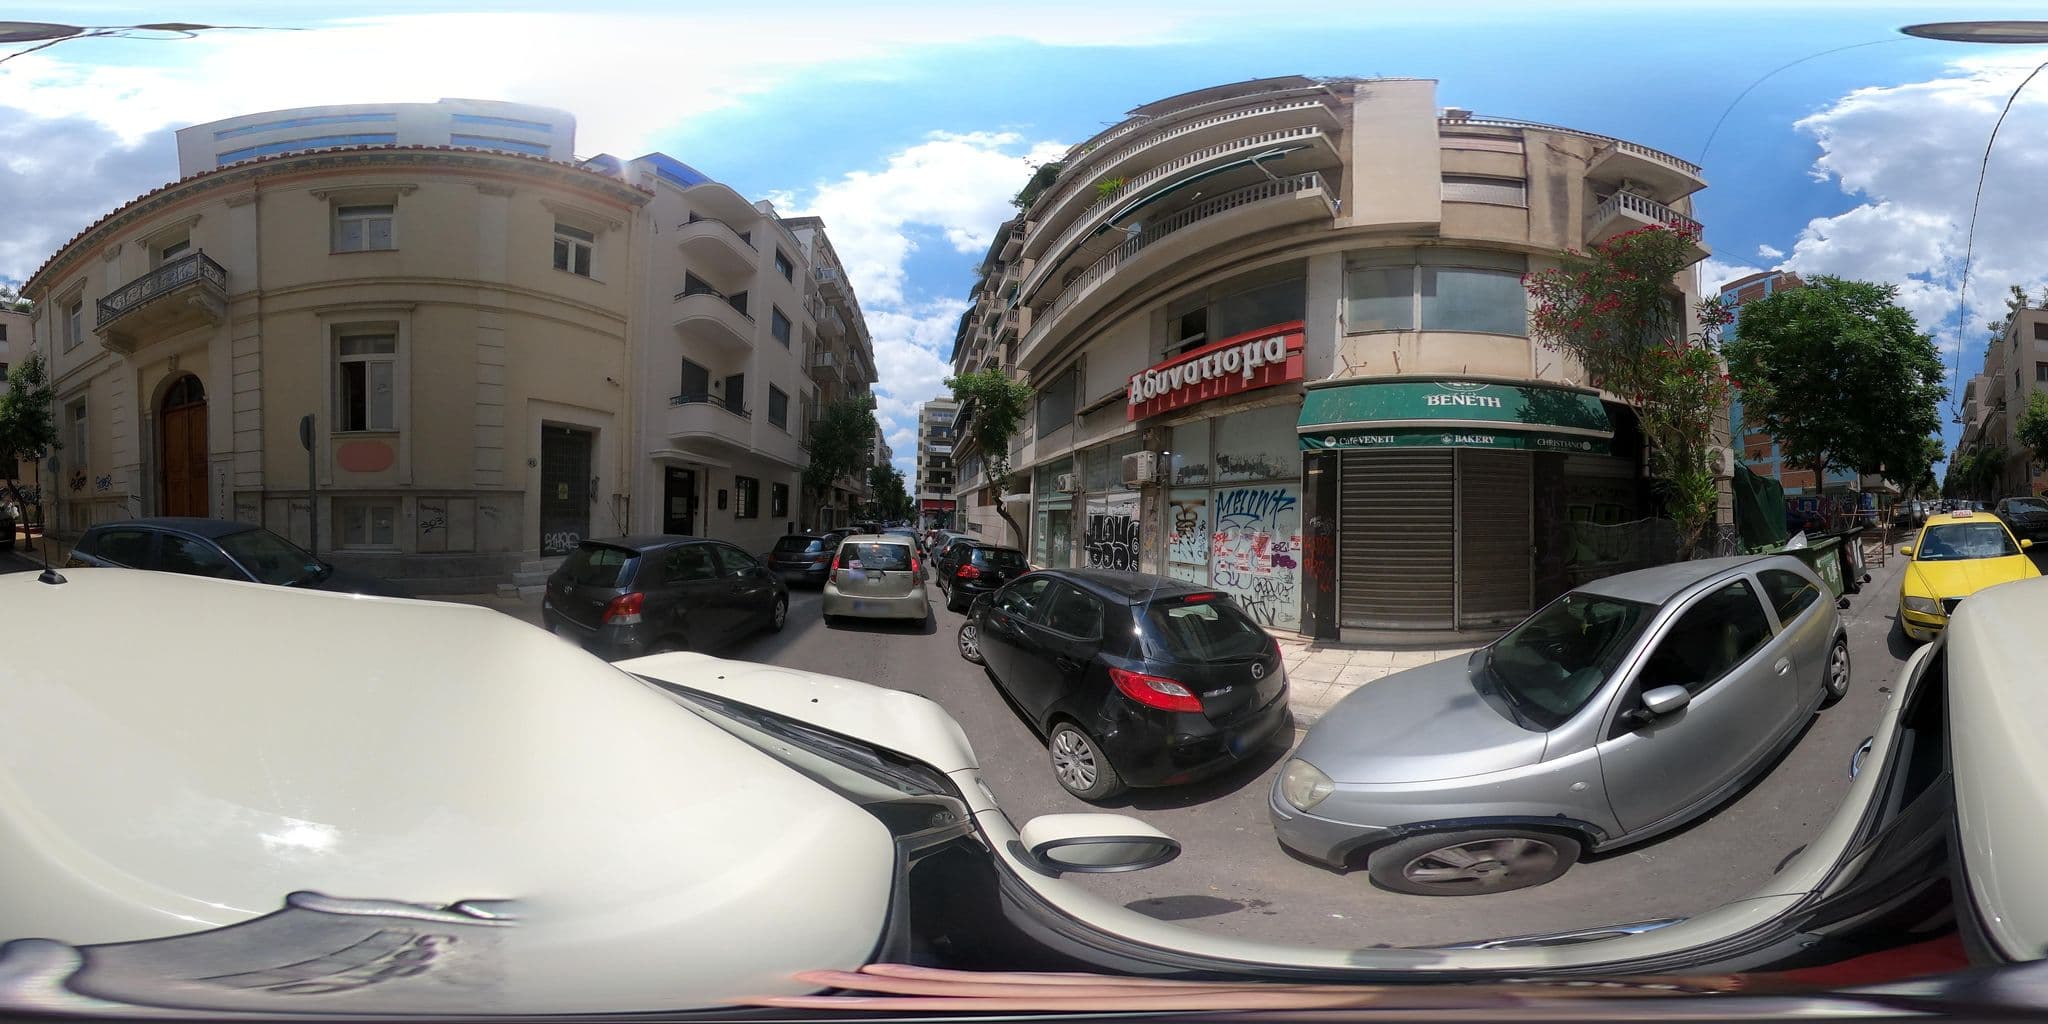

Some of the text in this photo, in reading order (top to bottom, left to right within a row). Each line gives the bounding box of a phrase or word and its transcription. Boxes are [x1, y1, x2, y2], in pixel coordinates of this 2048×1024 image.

[1129, 336, 1287, 405] Αδυνατισμα
[1427, 394, 1502, 408] BENETH
[1358, 435, 1395, 444] VENETI
[1455, 435, 1496, 444] BAKERY
